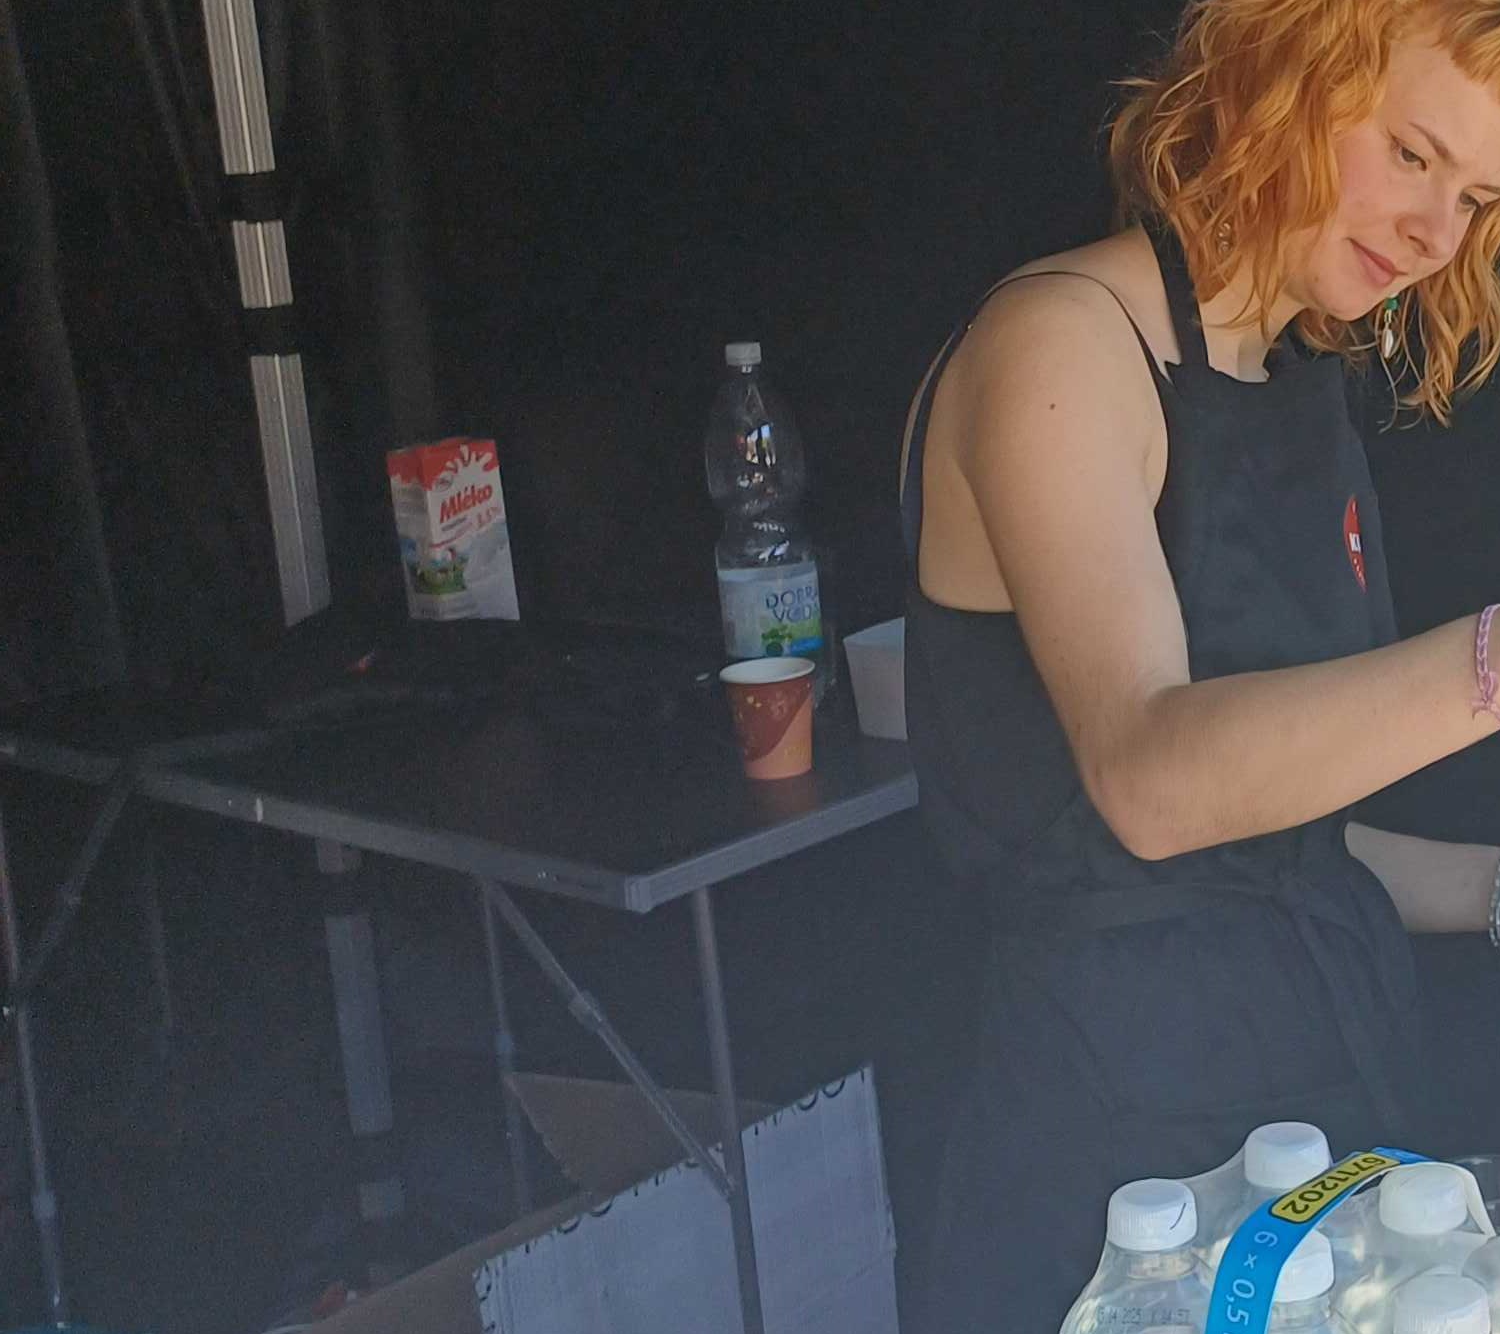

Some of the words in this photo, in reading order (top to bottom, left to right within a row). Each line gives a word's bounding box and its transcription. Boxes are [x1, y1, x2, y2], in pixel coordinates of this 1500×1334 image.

[439, 483, 493, 524] Mléko
[1282, 1155, 1387, 1216] 6711202
[1253, 1230, 1279, 1248] 6
[1226, 1279, 1256, 1326] 0,5
